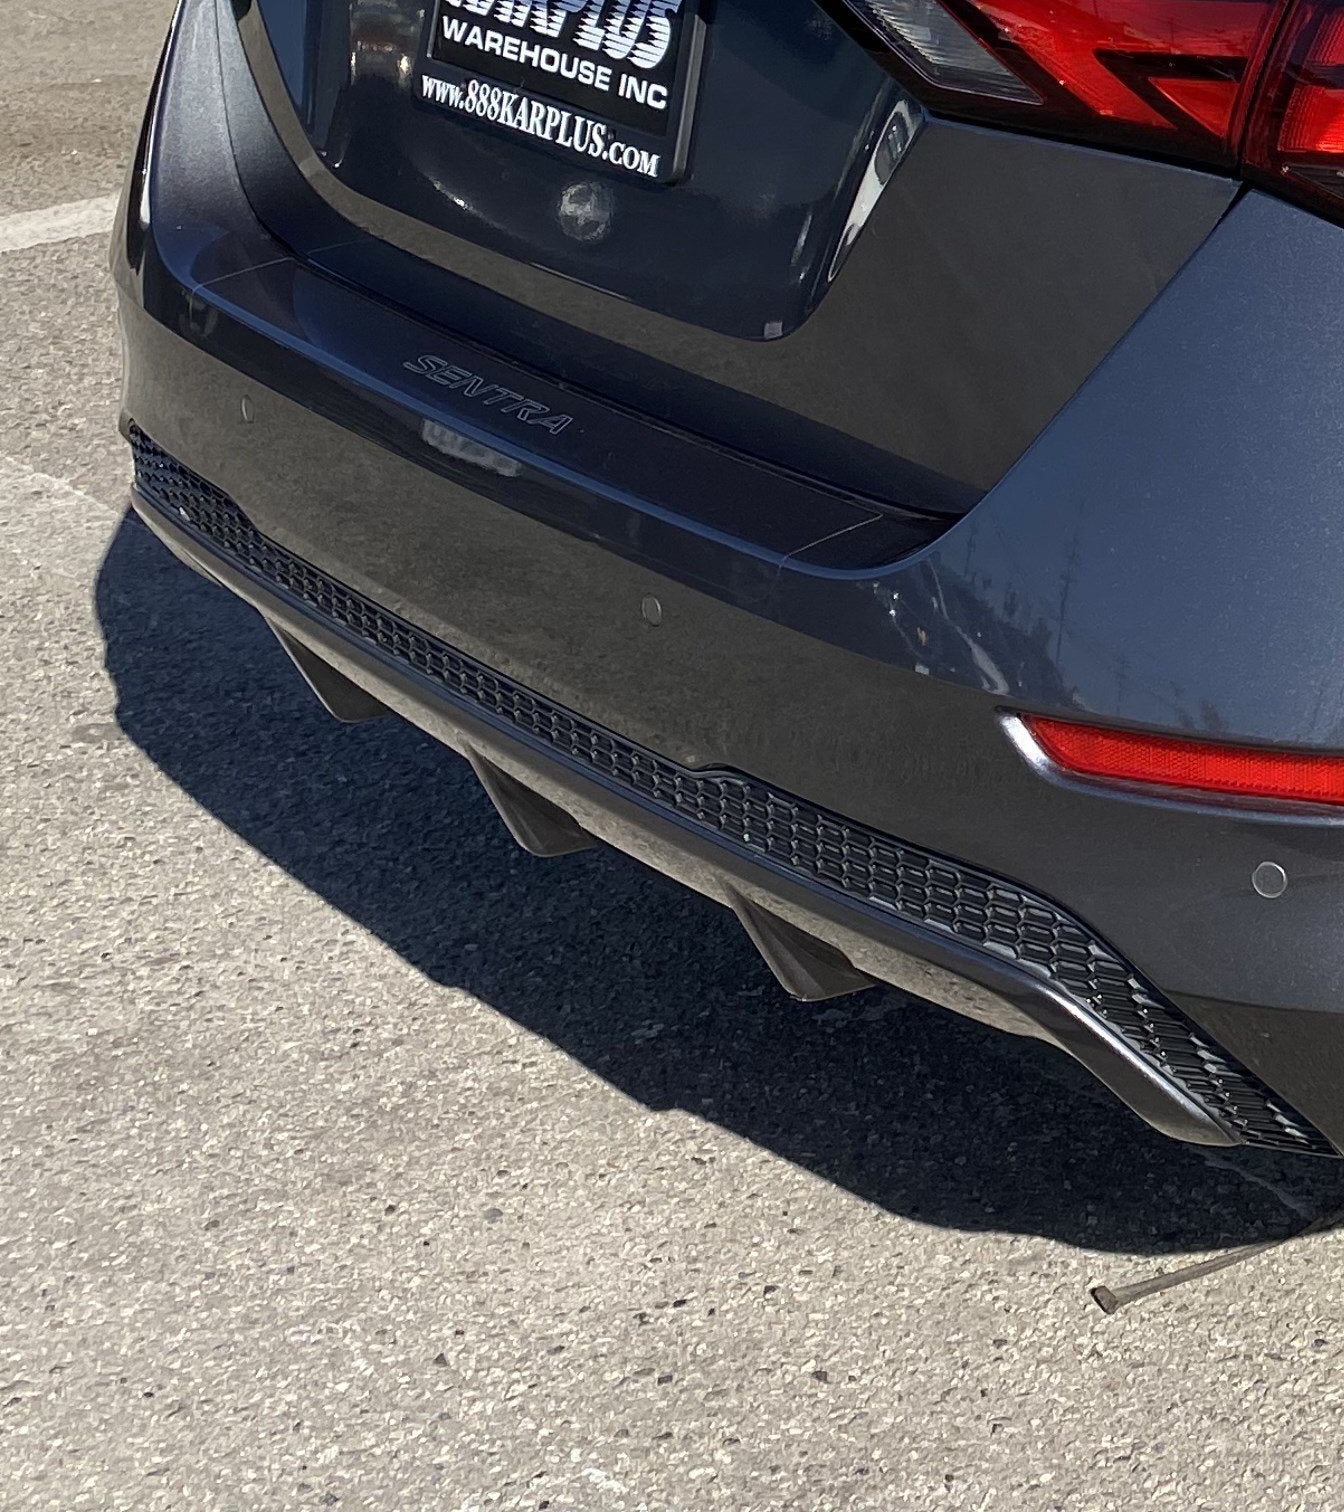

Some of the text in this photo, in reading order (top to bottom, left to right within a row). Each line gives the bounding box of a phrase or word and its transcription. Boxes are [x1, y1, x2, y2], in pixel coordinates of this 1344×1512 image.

[442, 15, 669, 110] WAREHOUSE INC
[402, 354, 574, 436] SENTRA
